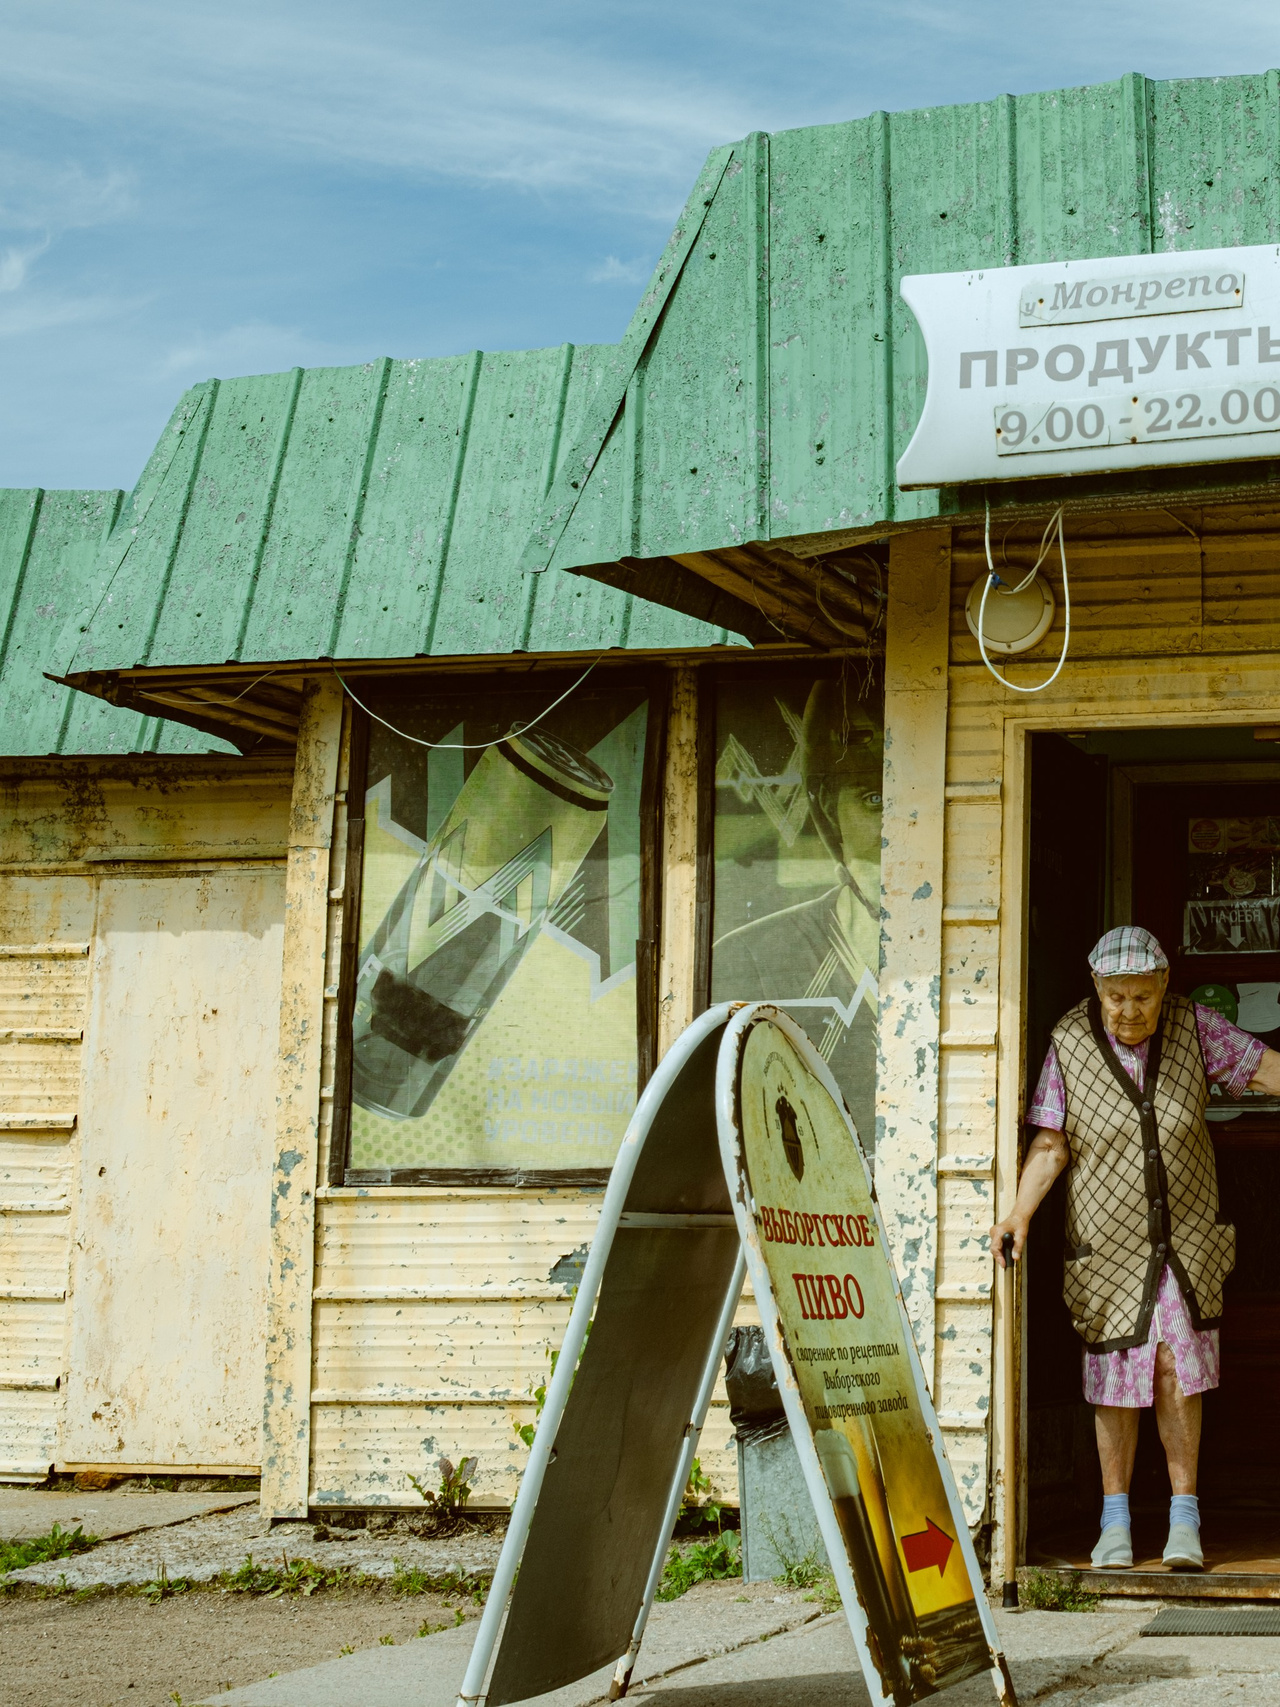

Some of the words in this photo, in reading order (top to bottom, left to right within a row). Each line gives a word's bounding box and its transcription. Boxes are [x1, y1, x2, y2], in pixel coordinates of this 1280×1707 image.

[1049, 272, 1238, 311] Монрепо
[1000, 403, 1105, 447] 9.00
[1210, 910, 1227, 924] НА
[485, 1088, 522, 1113] НА
[531, 1085, 635, 1115] НОВЫЙ
[484, 1119, 613, 1145] УРОВЕНЬ
[760, 1205, 875, 1248] ВЫБОРГСКОЕ
[792, 1273, 865, 1320] ПИВО
[796, 1345, 837, 1367] сваренное
[837, 1346, 848, 1361] по
[851, 1341, 900, 1366] рецептам
[823, 1369, 881, 1393] Выборгского
[815, 1398, 877, 1423] пивоваренного
[878, 1394, 909, 1416] завода
